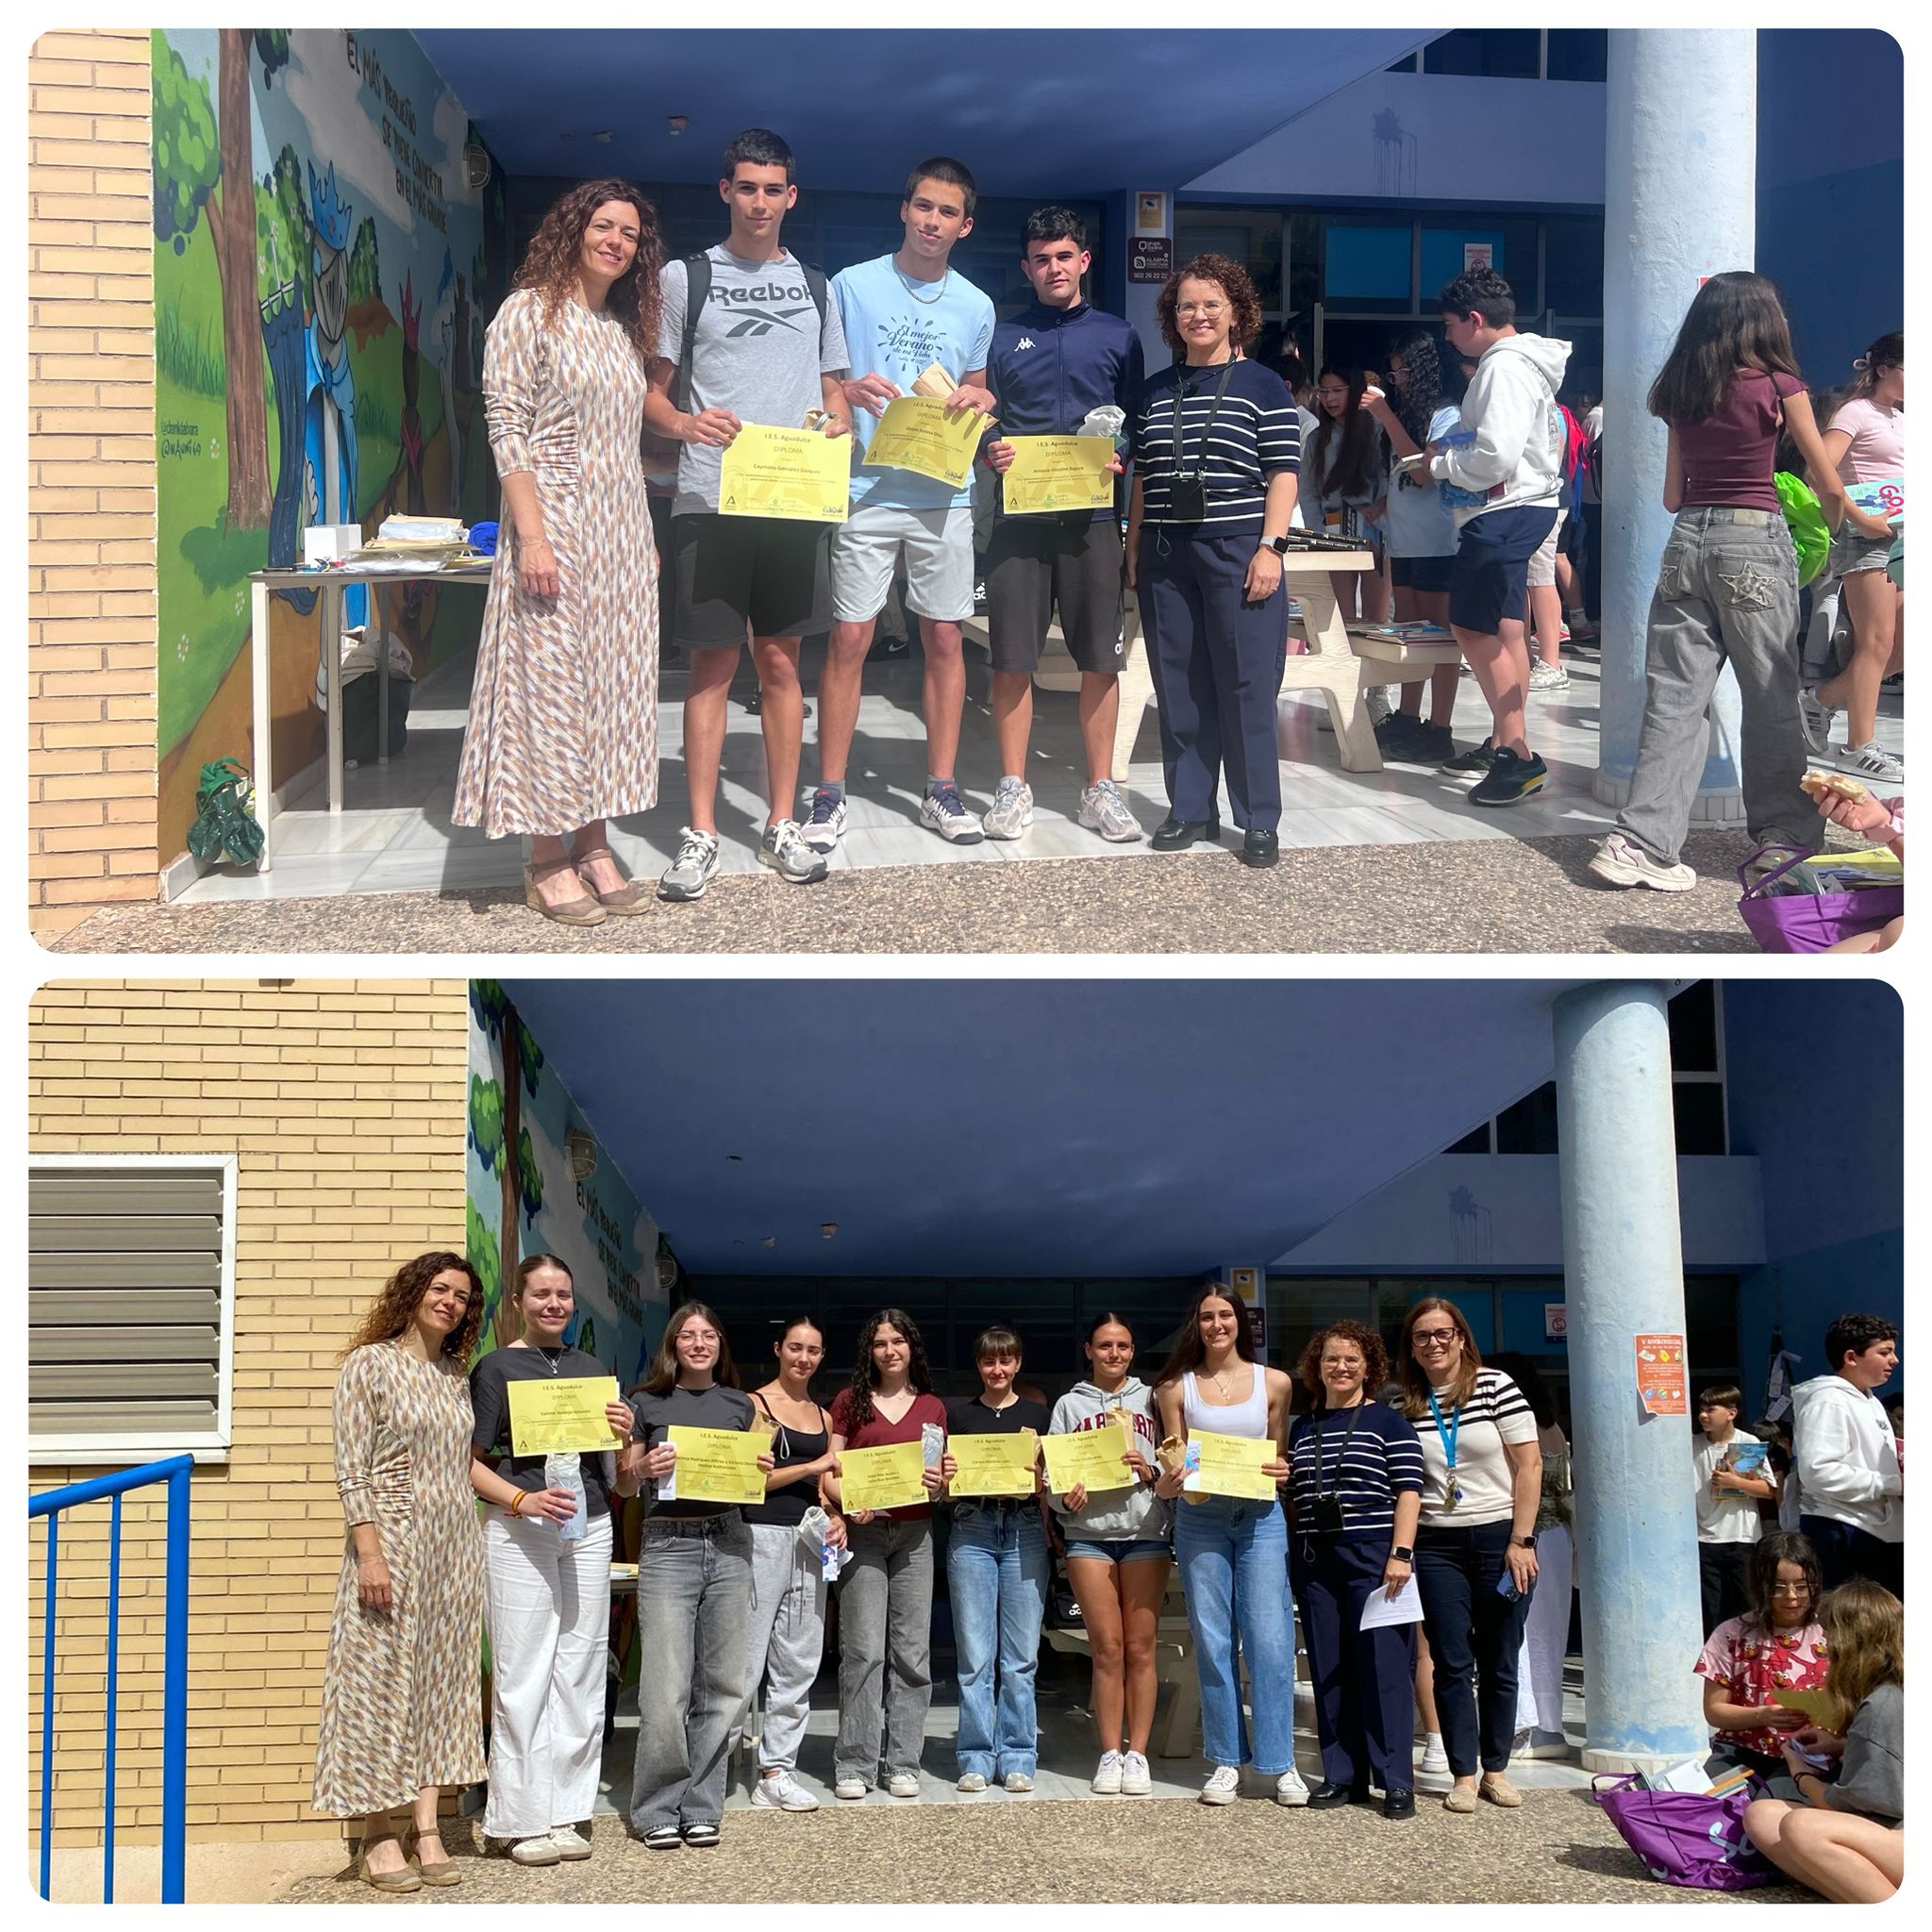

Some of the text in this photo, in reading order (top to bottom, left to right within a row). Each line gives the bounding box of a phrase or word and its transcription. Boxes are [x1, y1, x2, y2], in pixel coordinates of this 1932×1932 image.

[346, 32, 417, 136] EL MÁS PEQUEÑO
[382, 114, 391, 147] SE
[392, 125, 410, 168] PUEDE
[395, 169, 405, 199] EN
[406, 178, 413, 207] EL
[887, 331, 934, 351] Verano
[897, 325, 940, 342] El mejor
[924, 403, 944, 411] Aguadu
[774, 445, 803, 454] DIPLOMA
[576, 1180, 585, 1209] EL
